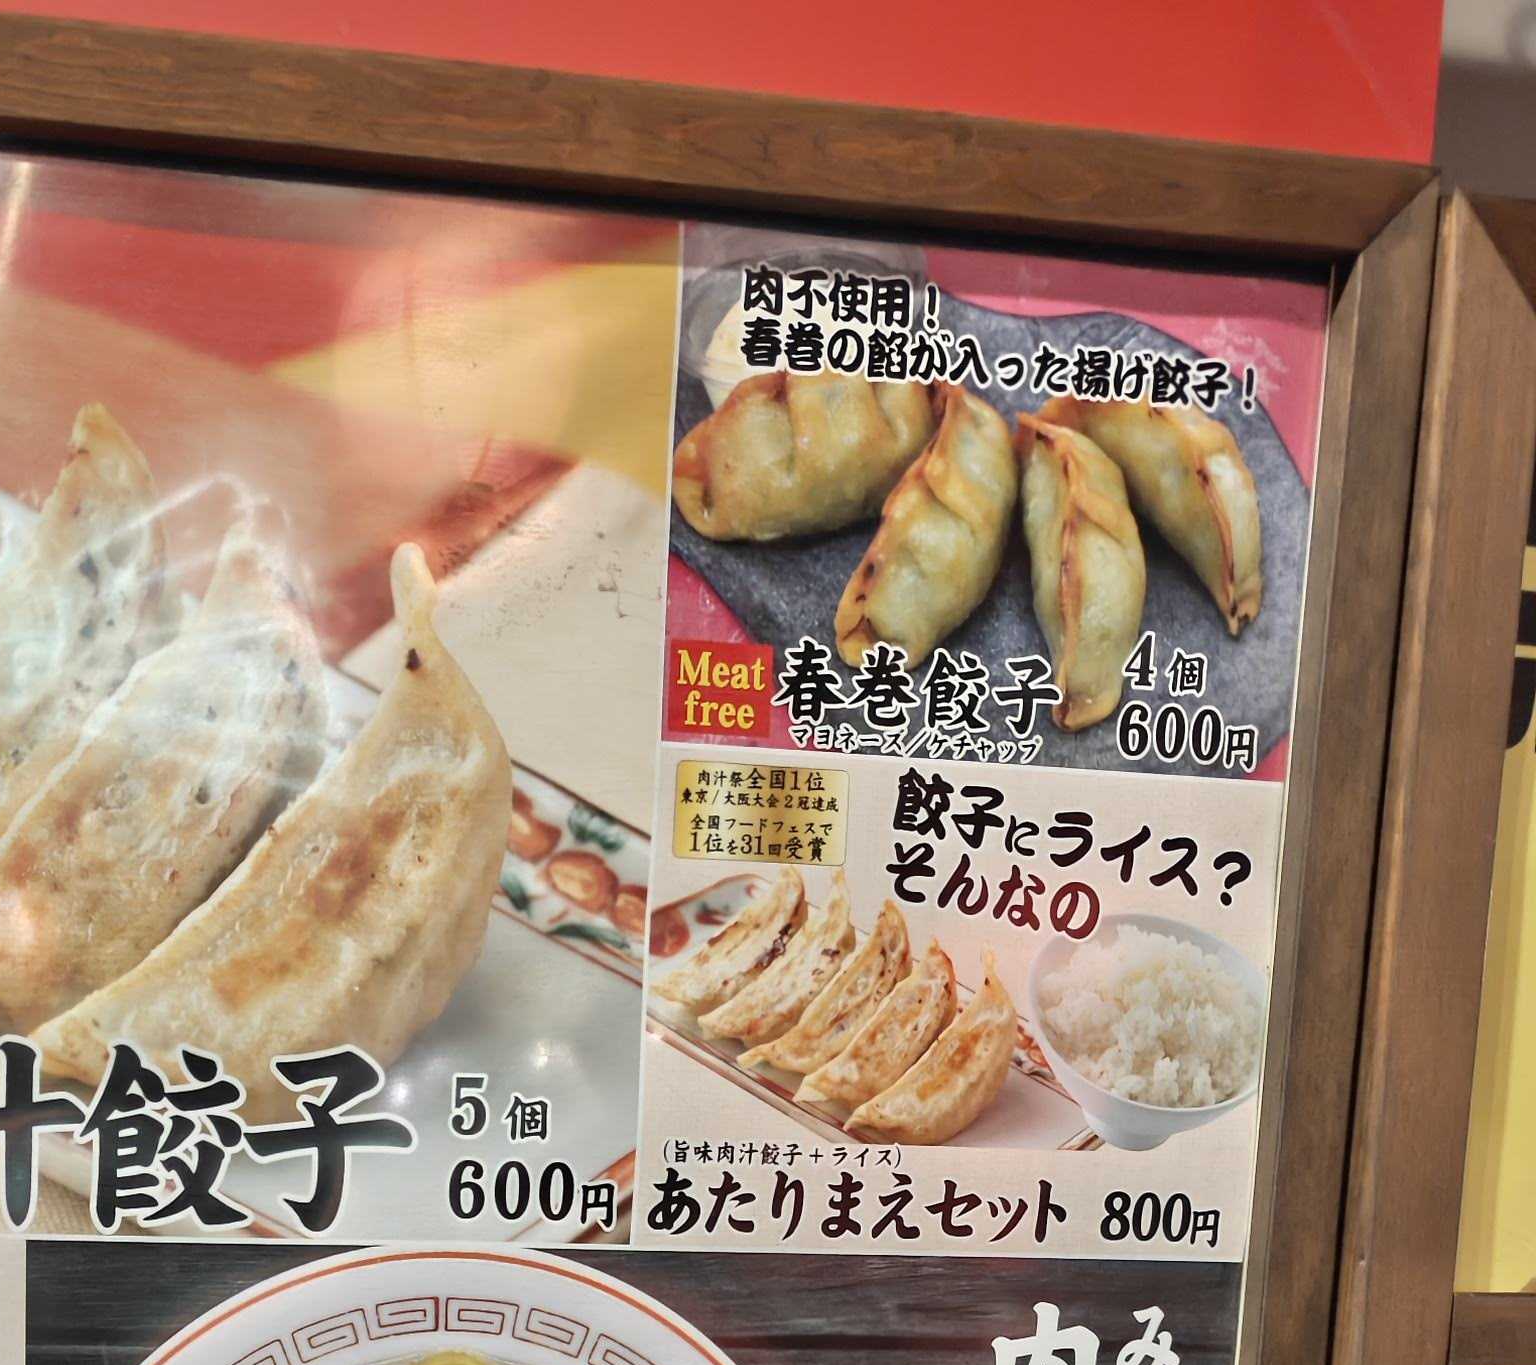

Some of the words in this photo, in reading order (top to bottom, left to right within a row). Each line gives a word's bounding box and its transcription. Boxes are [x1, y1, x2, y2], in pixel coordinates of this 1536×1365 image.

[742, 266, 941, 330] 肉不使用！
[677, 649, 765, 691] Meat
[774, 638, 1063, 737] 春巻餃子
[1123, 633, 1207, 696] 4個
[683, 690, 756, 730] free
[1117, 704, 1256, 771] 600円
[697, 767, 825, 794] 肉汁祭全国1位
[689, 814, 833, 838] 全国フードフェスで
[689, 832, 827, 862] 1位を31回受賞
[893, 767, 1253, 907] 餃子にライス？
[886, 843, 1101, 941] そんなの
[449, 1076, 551, 1142] 5個
[663, 1142, 902, 1169] （旨味肉汁餃子＋ライス）
[447, 1159, 618, 1231] 600円
[647, 1166, 1068, 1243] あたりまえセット
[1100, 1191, 1220, 1248] 800円
